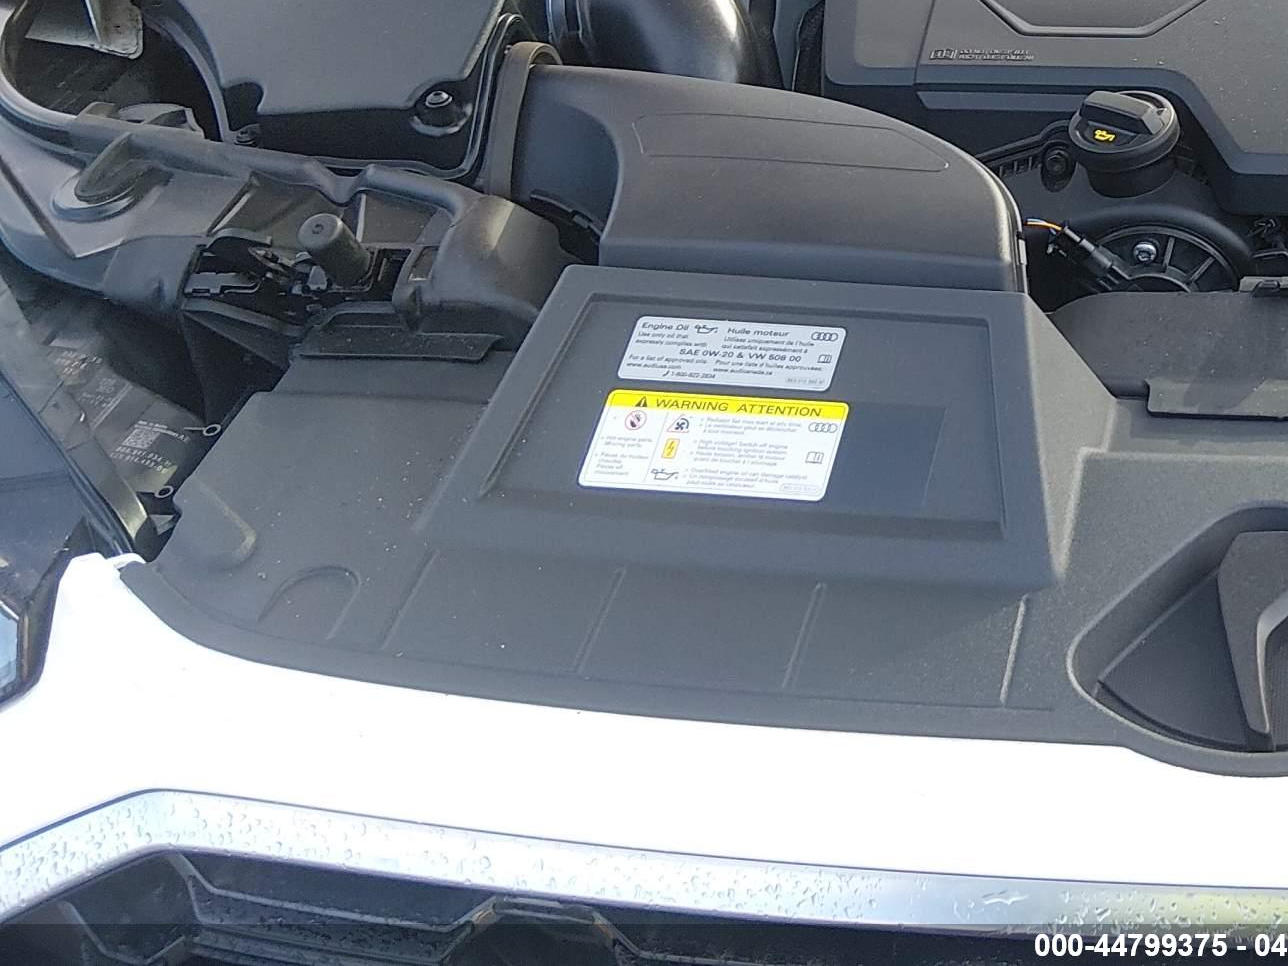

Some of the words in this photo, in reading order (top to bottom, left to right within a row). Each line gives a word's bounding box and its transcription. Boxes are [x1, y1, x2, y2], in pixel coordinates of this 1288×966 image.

[642, 322, 673, 331] Engine
[702, 350, 734, 358] 0W-20
[656, 398, 729, 412] WARNING
[736, 403, 822, 417] ATTENTION
